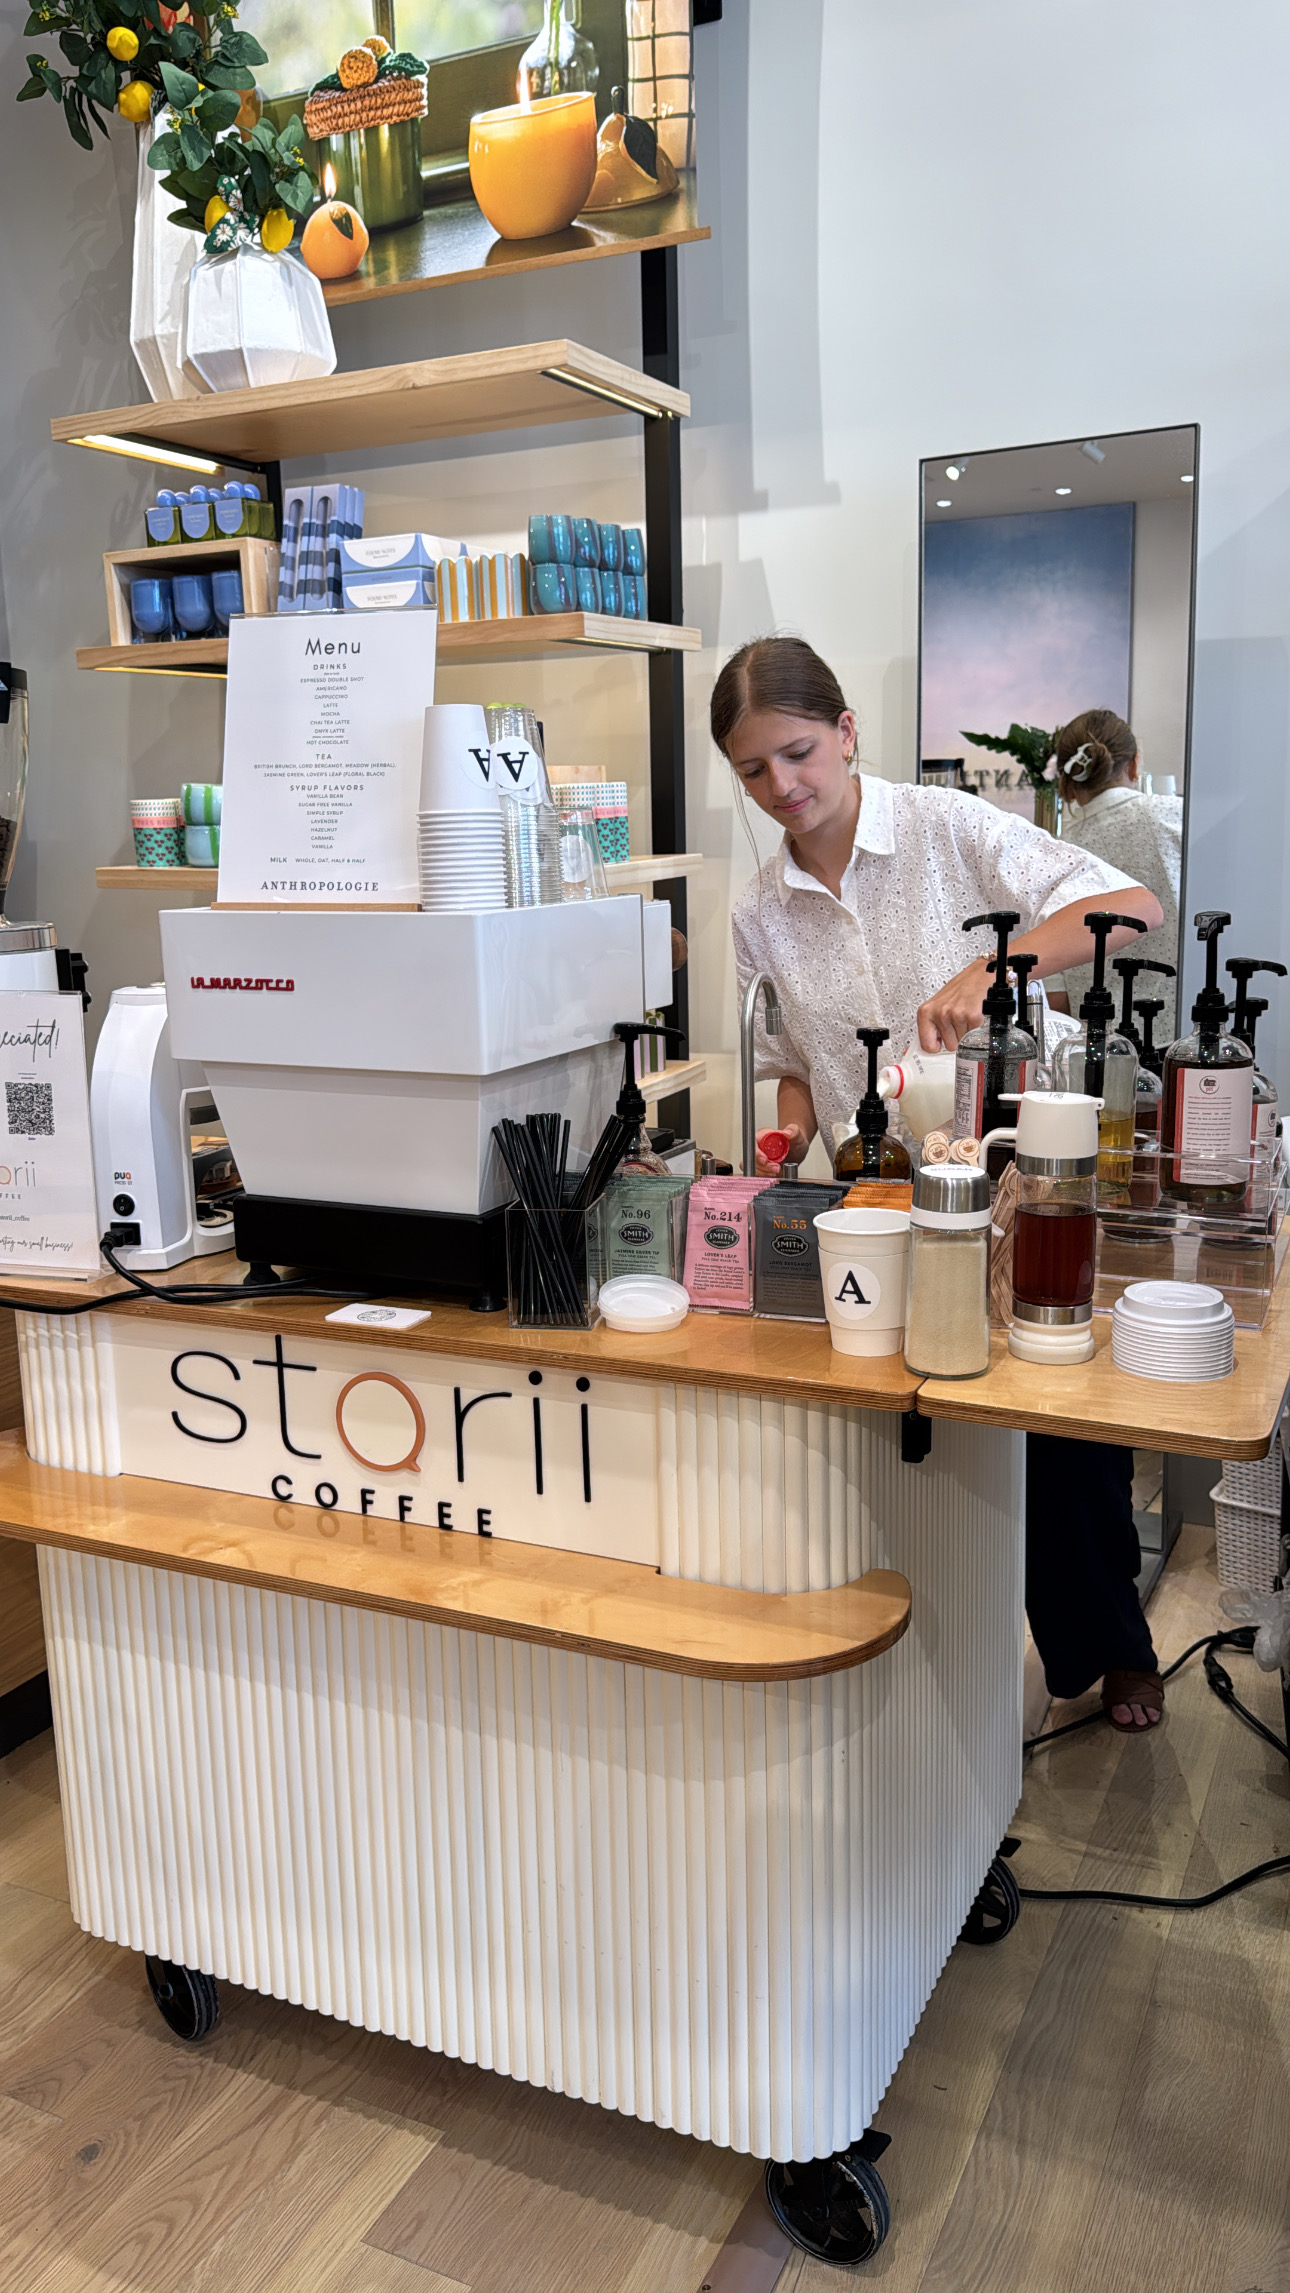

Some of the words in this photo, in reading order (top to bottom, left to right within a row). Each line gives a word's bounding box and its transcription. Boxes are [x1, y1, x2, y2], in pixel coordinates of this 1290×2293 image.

[305, 637, 361, 656] Menu
[313, 663, 348, 671] DRINKS
[468, 748, 490, 782] A
[497, 751, 529, 782] A
[260, 881, 379, 891] ANTHROPOLOGIE
[0, 1018, 60, 1062] eciated!
[621, 1209, 651, 1219] No.96
[704, 1212, 742, 1222] No.214
[709, 1233, 734, 1241] SMITH
[834, 1270, 871, 1304] A
[170, 1334, 592, 1503] storii
[271, 1474, 492, 1538] COFFEE
